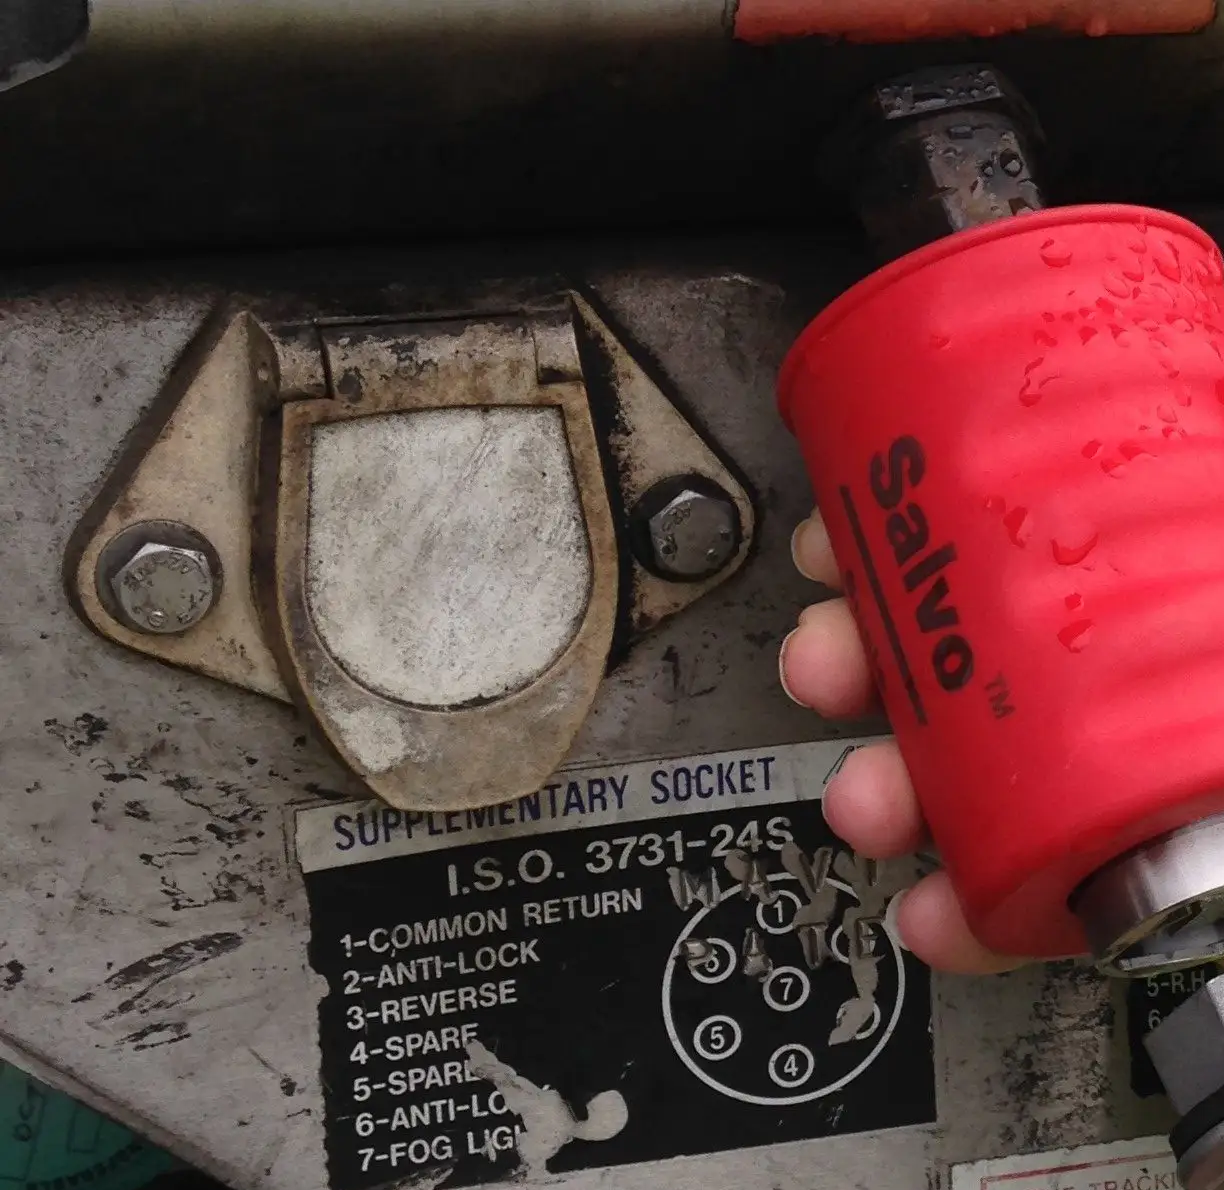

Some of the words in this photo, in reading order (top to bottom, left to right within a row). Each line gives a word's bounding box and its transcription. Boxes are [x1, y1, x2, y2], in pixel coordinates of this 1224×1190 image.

[869, 435, 974, 692] Salvo
[334, 775, 629, 851] SUPPLEMENTARY
[651, 756, 776, 804] SOCKET
[447, 848, 566, 897] I.S.O.
[585, 816, 794, 875] 3731-24S
[340, 908, 508, 951] 1-COMMON
[522, 887, 643, 927] RETURN
[772, 899, 784, 924] 1
[343, 938, 541, 996] 2-ANTI-LOCK
[779, 977, 794, 1001] 7
[1147, 968, 1206, 997] 5-R.H
[346, 979, 518, 1031] 3-REVERSE
[709, 1025, 726, 1050] 5
[783, 1053, 799, 1077] 4
[355, 1091, 511, 1137] 6-ANTI-LO
[357, 1135, 453, 1172] 7-FOG
